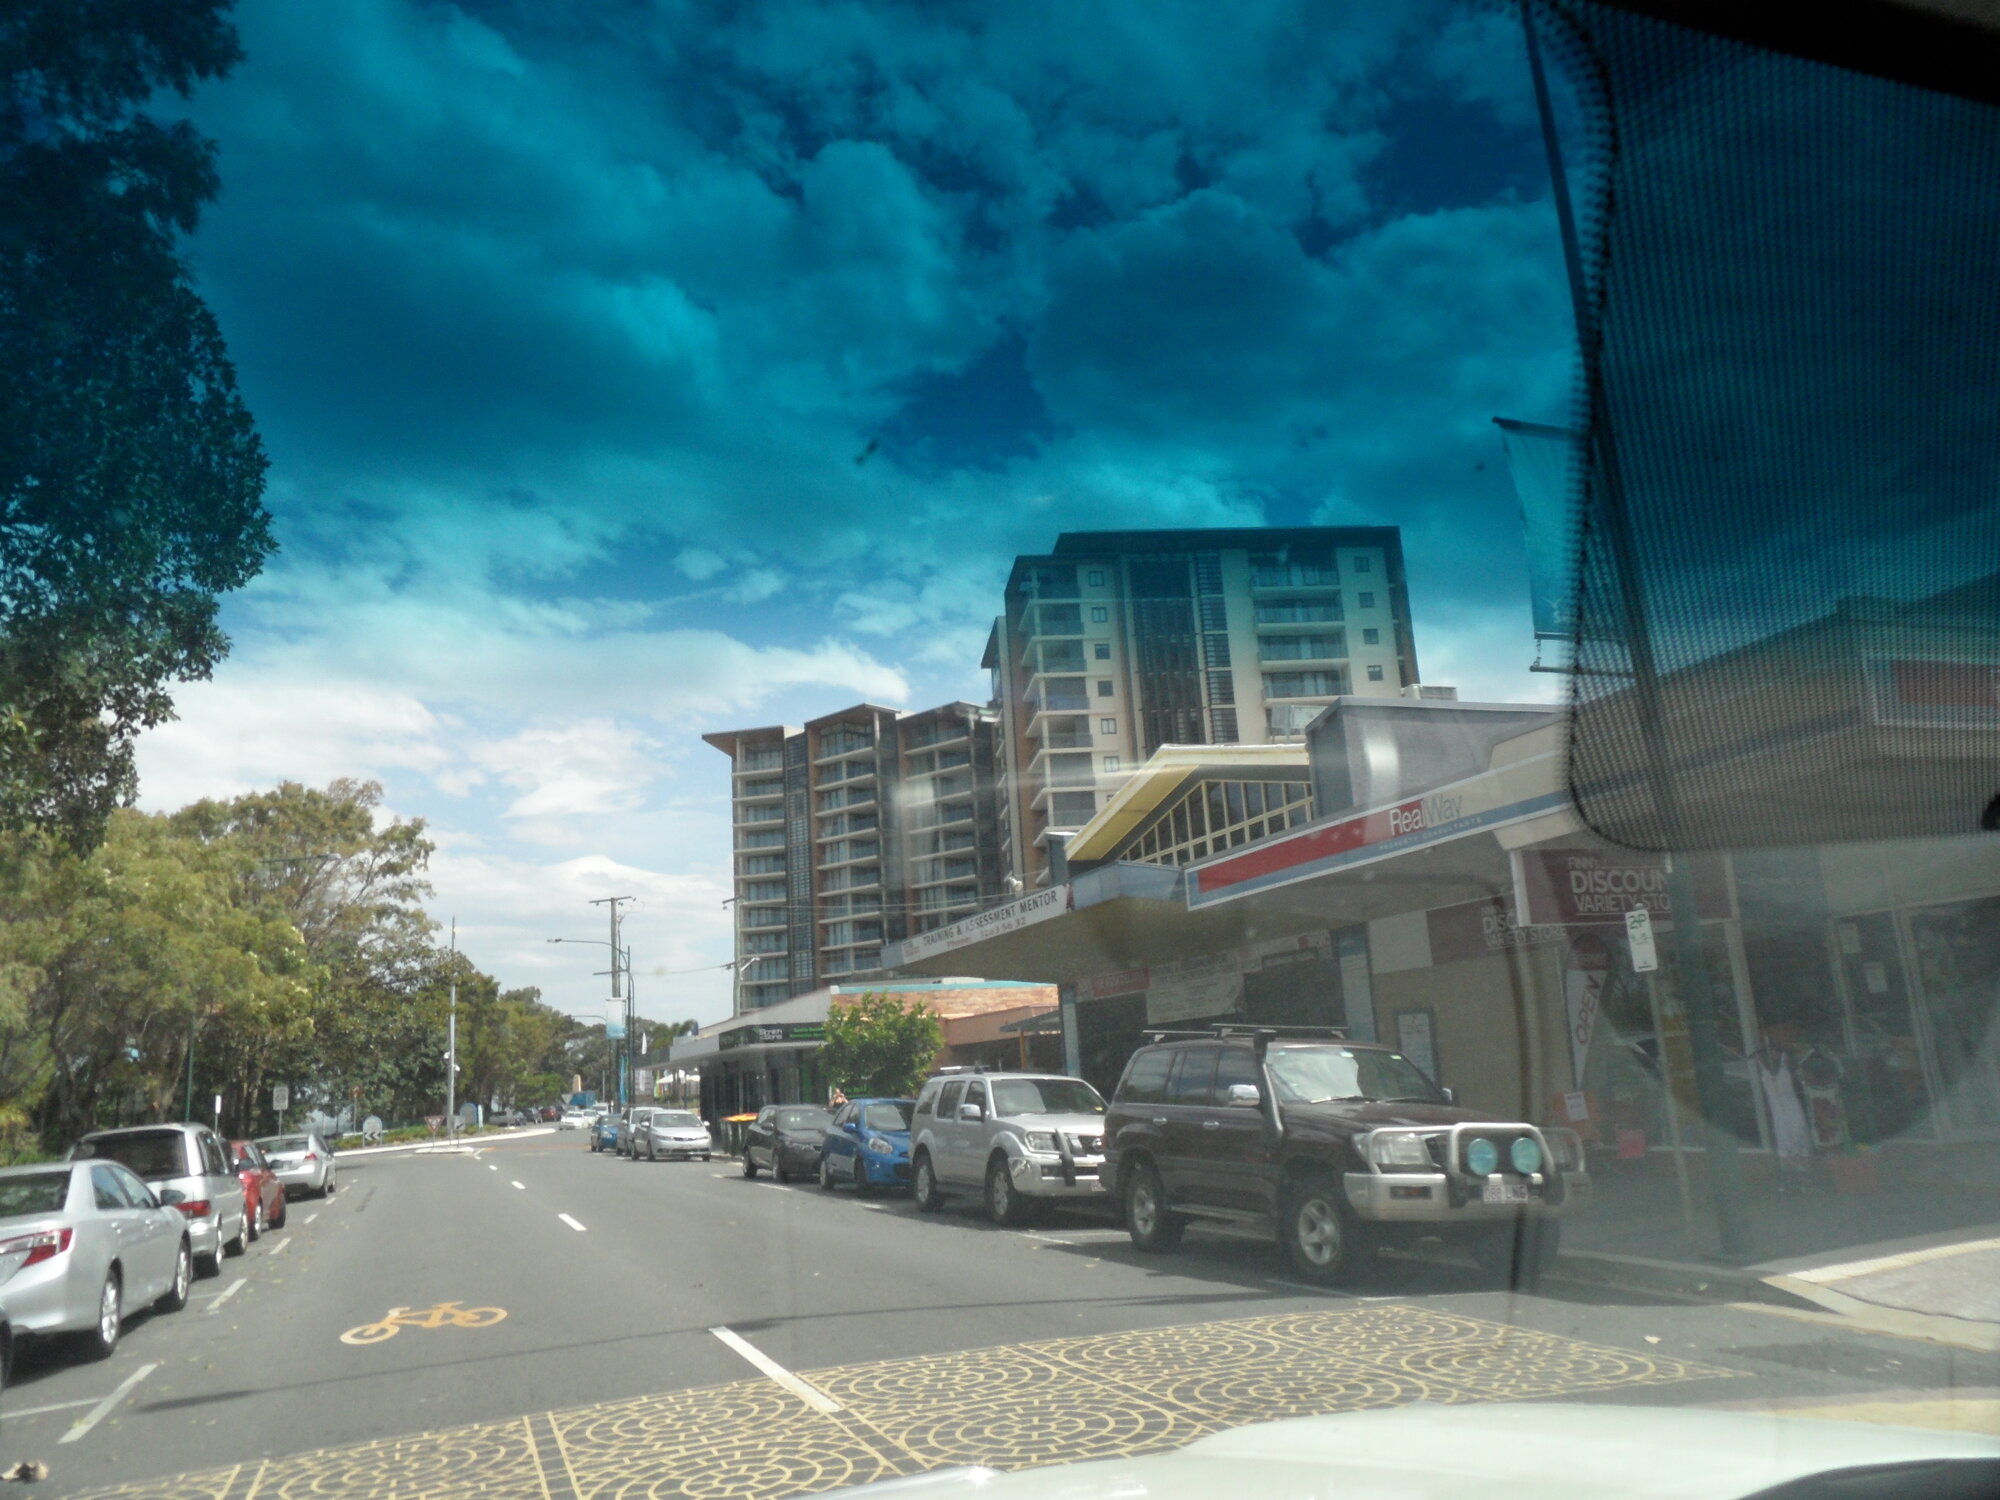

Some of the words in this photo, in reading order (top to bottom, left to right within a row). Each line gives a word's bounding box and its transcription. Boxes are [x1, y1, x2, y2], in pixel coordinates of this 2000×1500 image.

[1570, 869, 1668, 893] DISCOUN
[1573, 892, 1640, 912] VARIETY
[1642, 893, 1671, 911] STO
[923, 927, 954, 946] TRAINING
[965, 905, 1016, 932] ASSESSMENT
[1019, 890, 1058, 913] MENTOR
[1628, 913, 1647, 929] 2P
[1576, 974, 1600, 1046] OPEN
